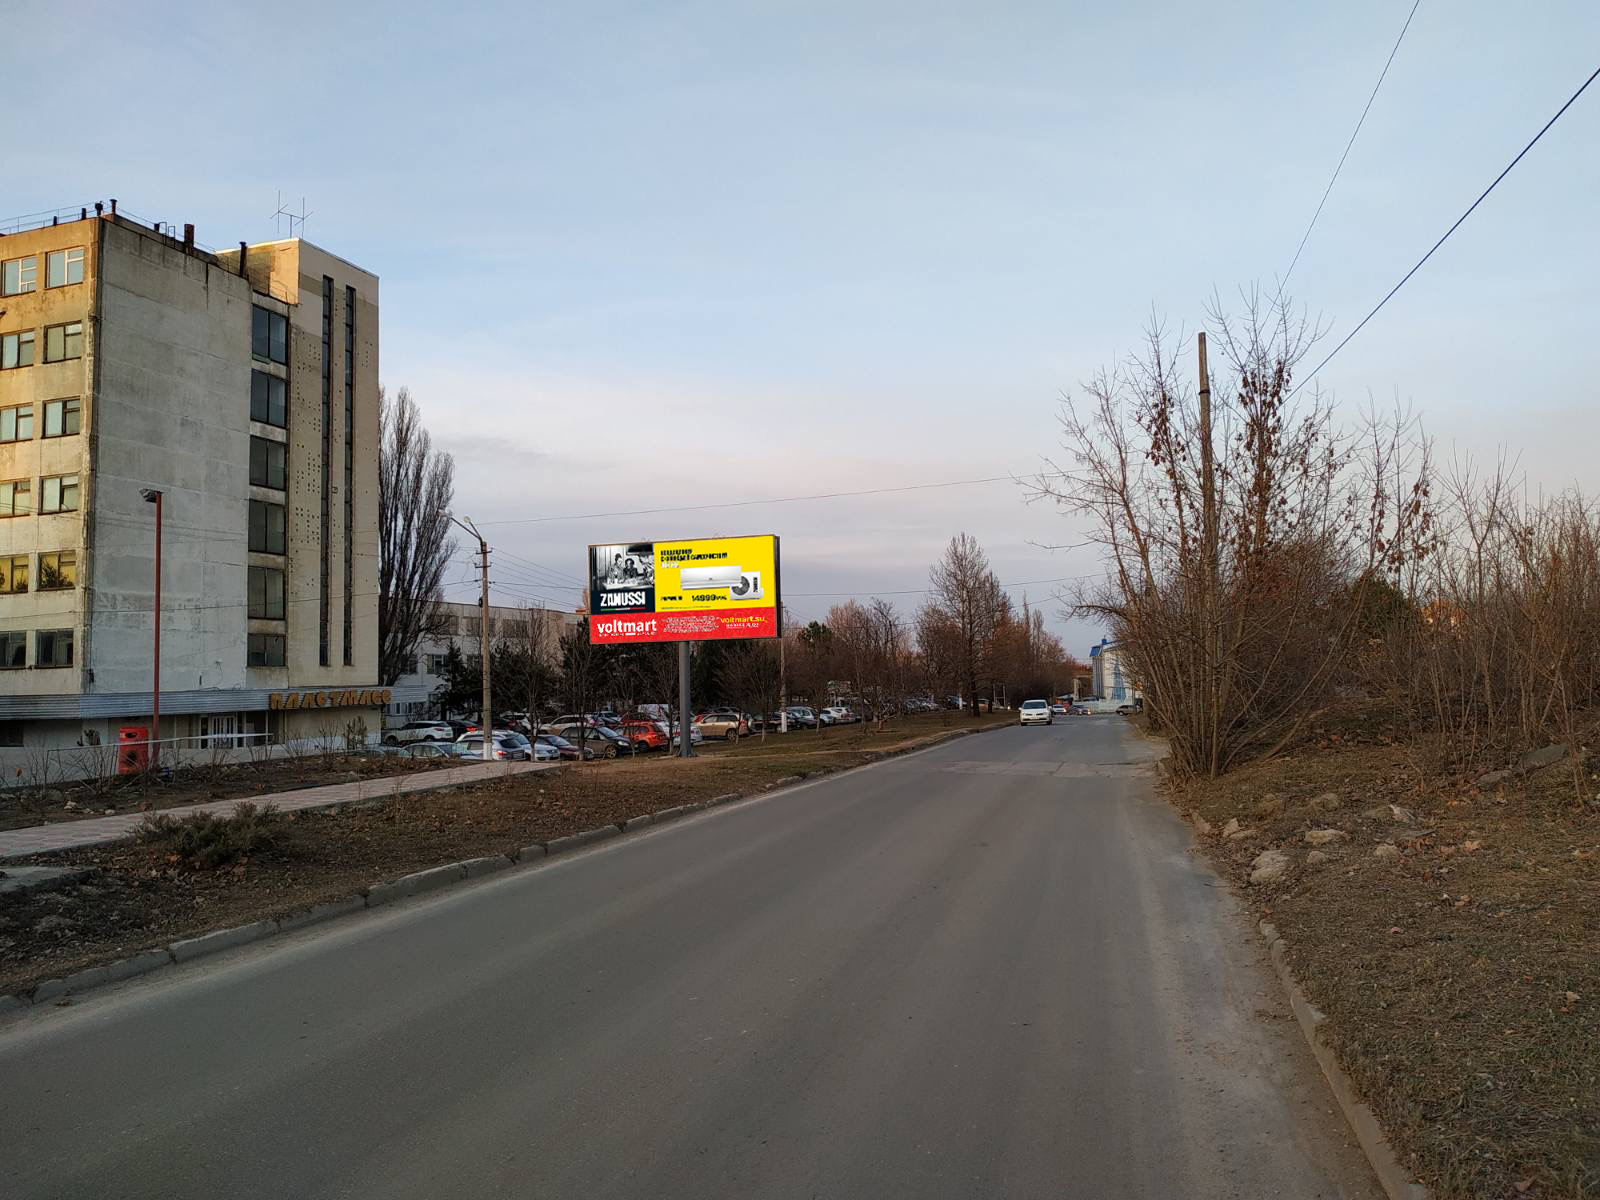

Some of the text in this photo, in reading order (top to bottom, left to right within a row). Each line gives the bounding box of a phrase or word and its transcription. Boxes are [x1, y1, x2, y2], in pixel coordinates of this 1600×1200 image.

[600, 591, 646, 607] ZANUSSI
[597, 619, 657, 633] voltmart
[720, 615, 765, 624] voltmart.su
